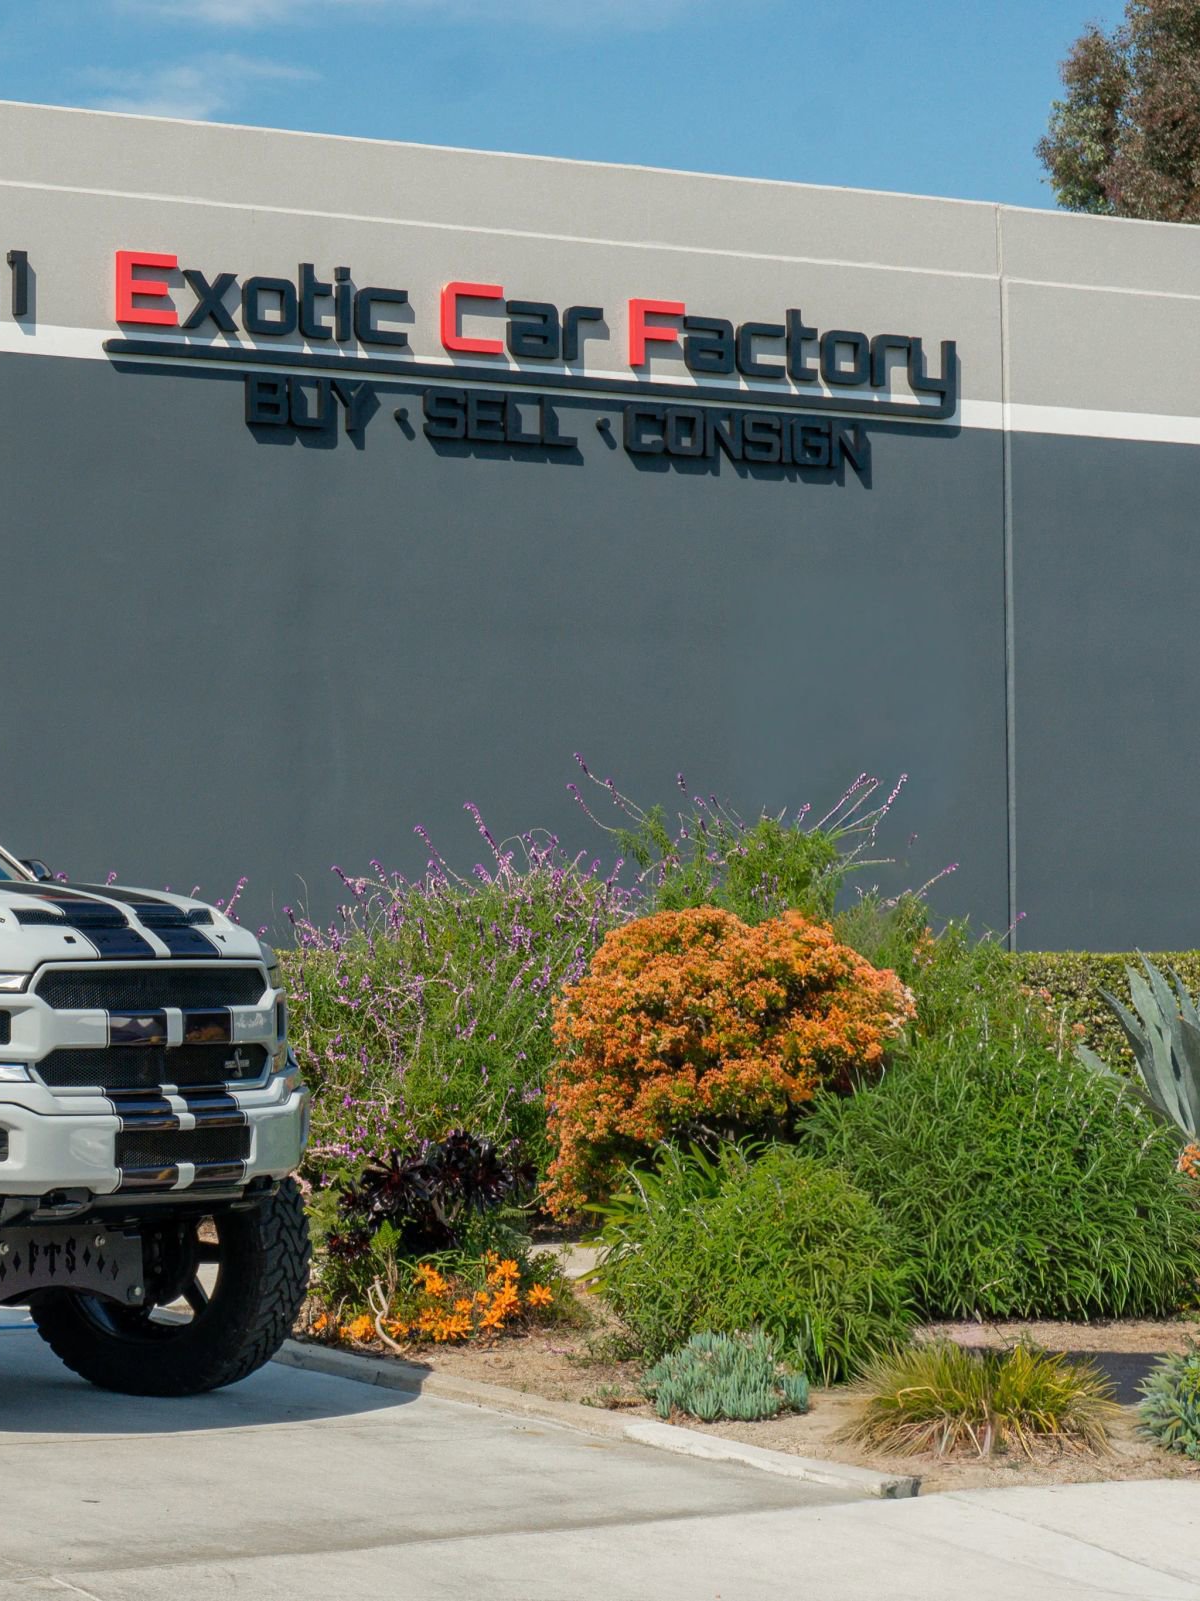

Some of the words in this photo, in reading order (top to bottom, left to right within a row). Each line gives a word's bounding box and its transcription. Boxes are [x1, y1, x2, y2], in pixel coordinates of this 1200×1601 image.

[115, 249, 409, 347] Exotic
[440, 280, 604, 361] Car
[627, 297, 957, 418] Factory
[245, 374, 366, 431] BUY
[422, 387, 578, 447] SELL
[622, 403, 868, 471] CONSIGN
